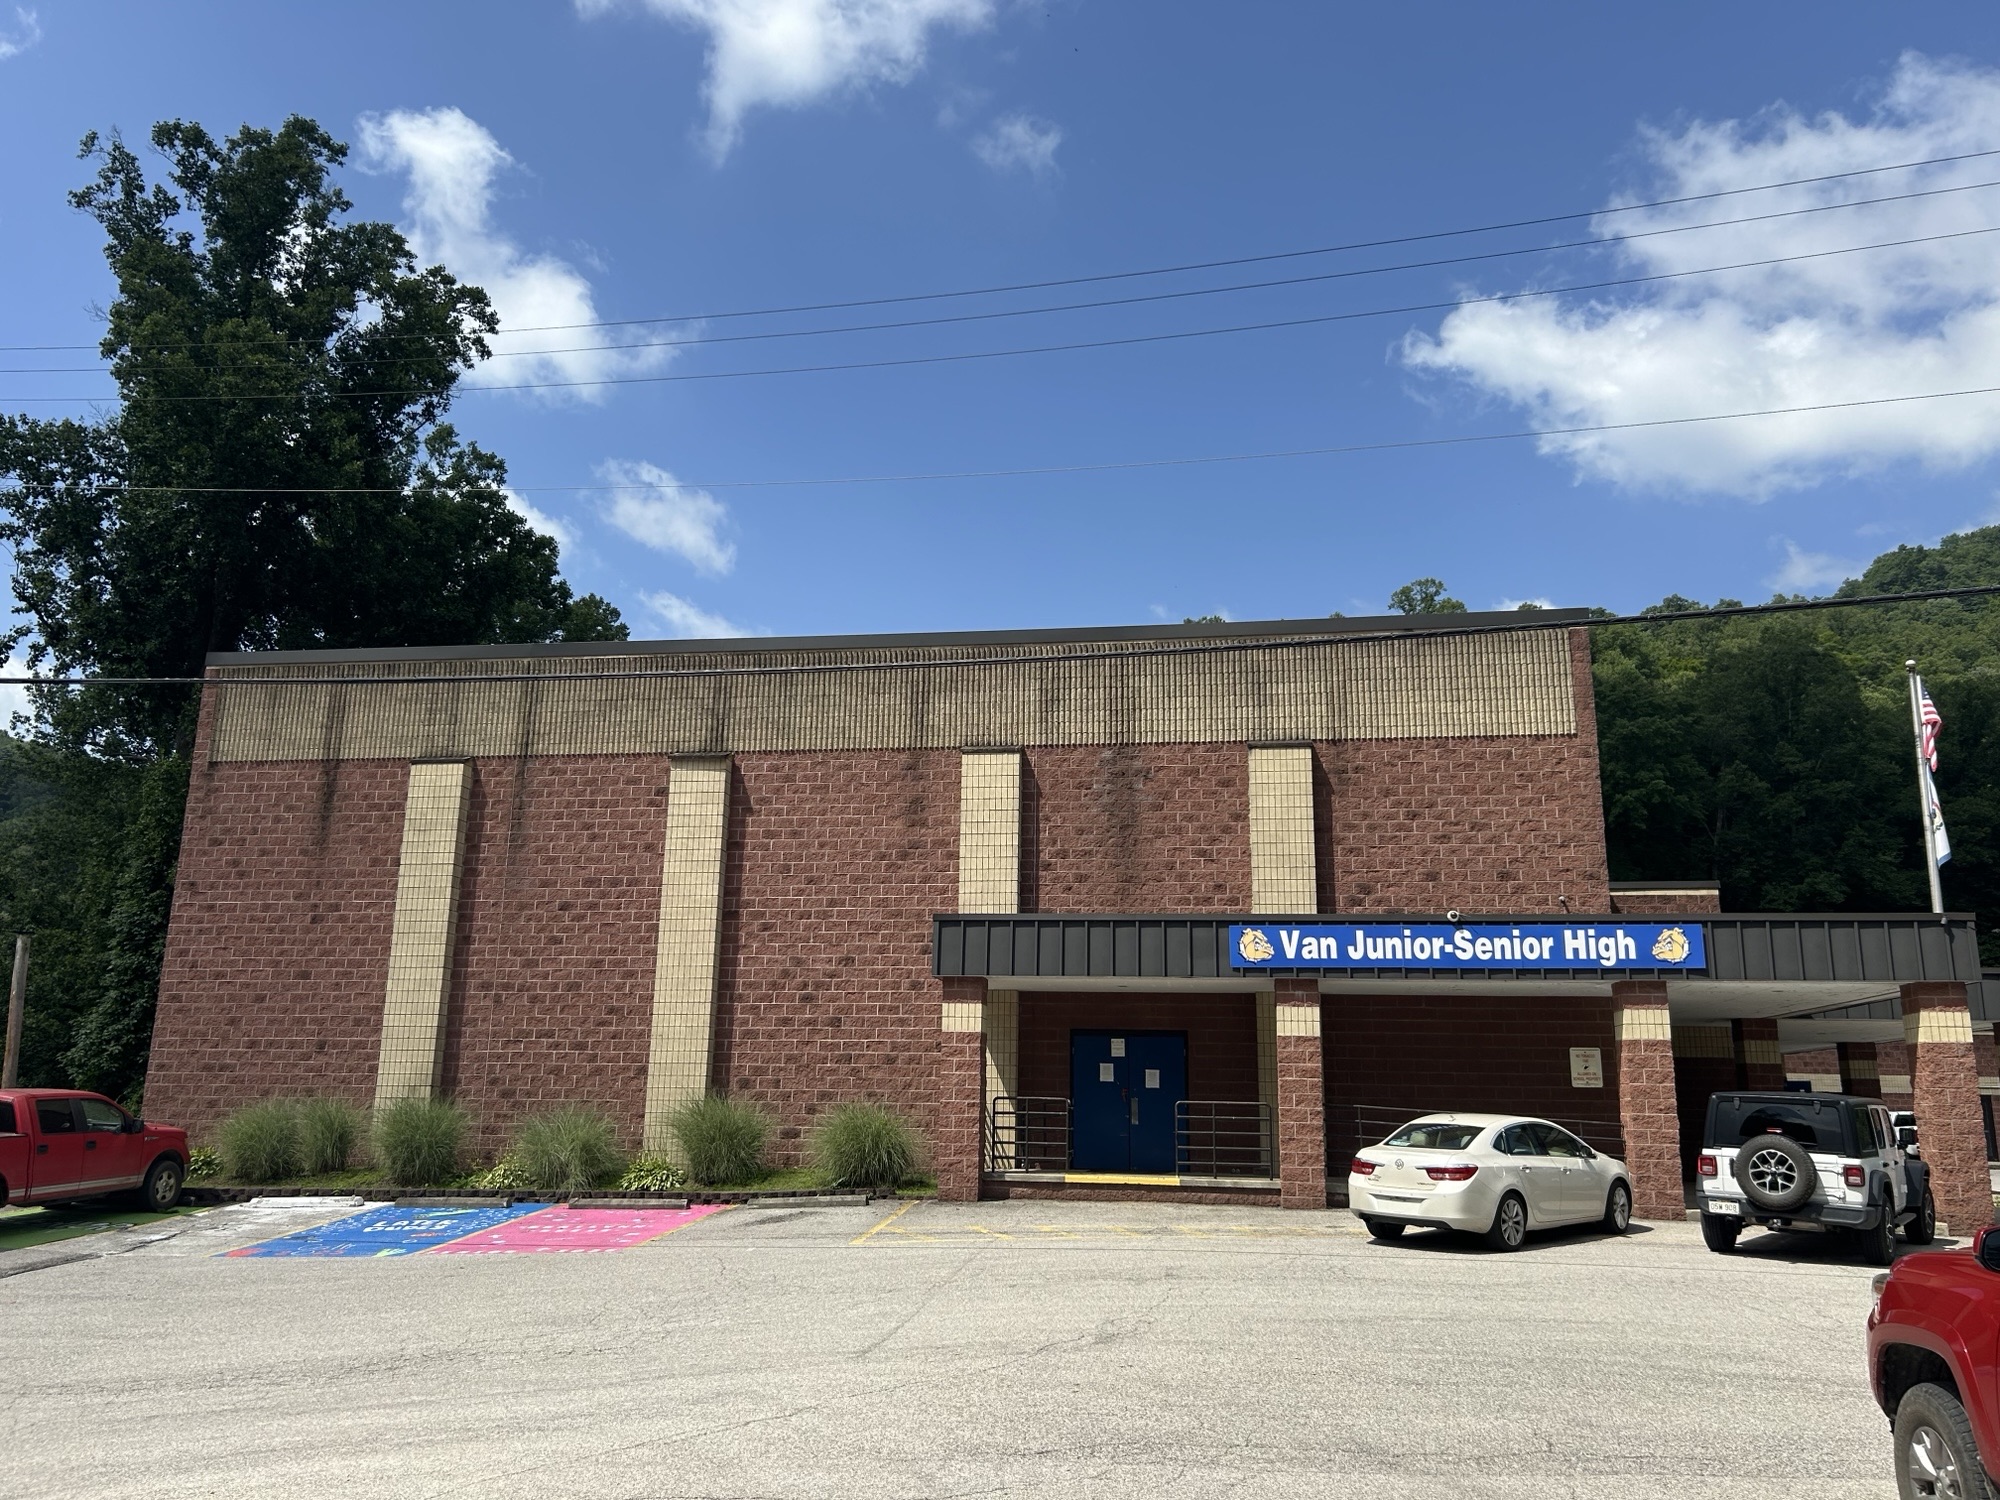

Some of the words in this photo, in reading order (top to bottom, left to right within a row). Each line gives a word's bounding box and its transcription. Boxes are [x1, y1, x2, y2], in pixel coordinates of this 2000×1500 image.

[1279, 929, 1338, 960] Van
[1347, 929, 1554, 961] Junior-Senior
[1563, 929, 1637, 967] High
